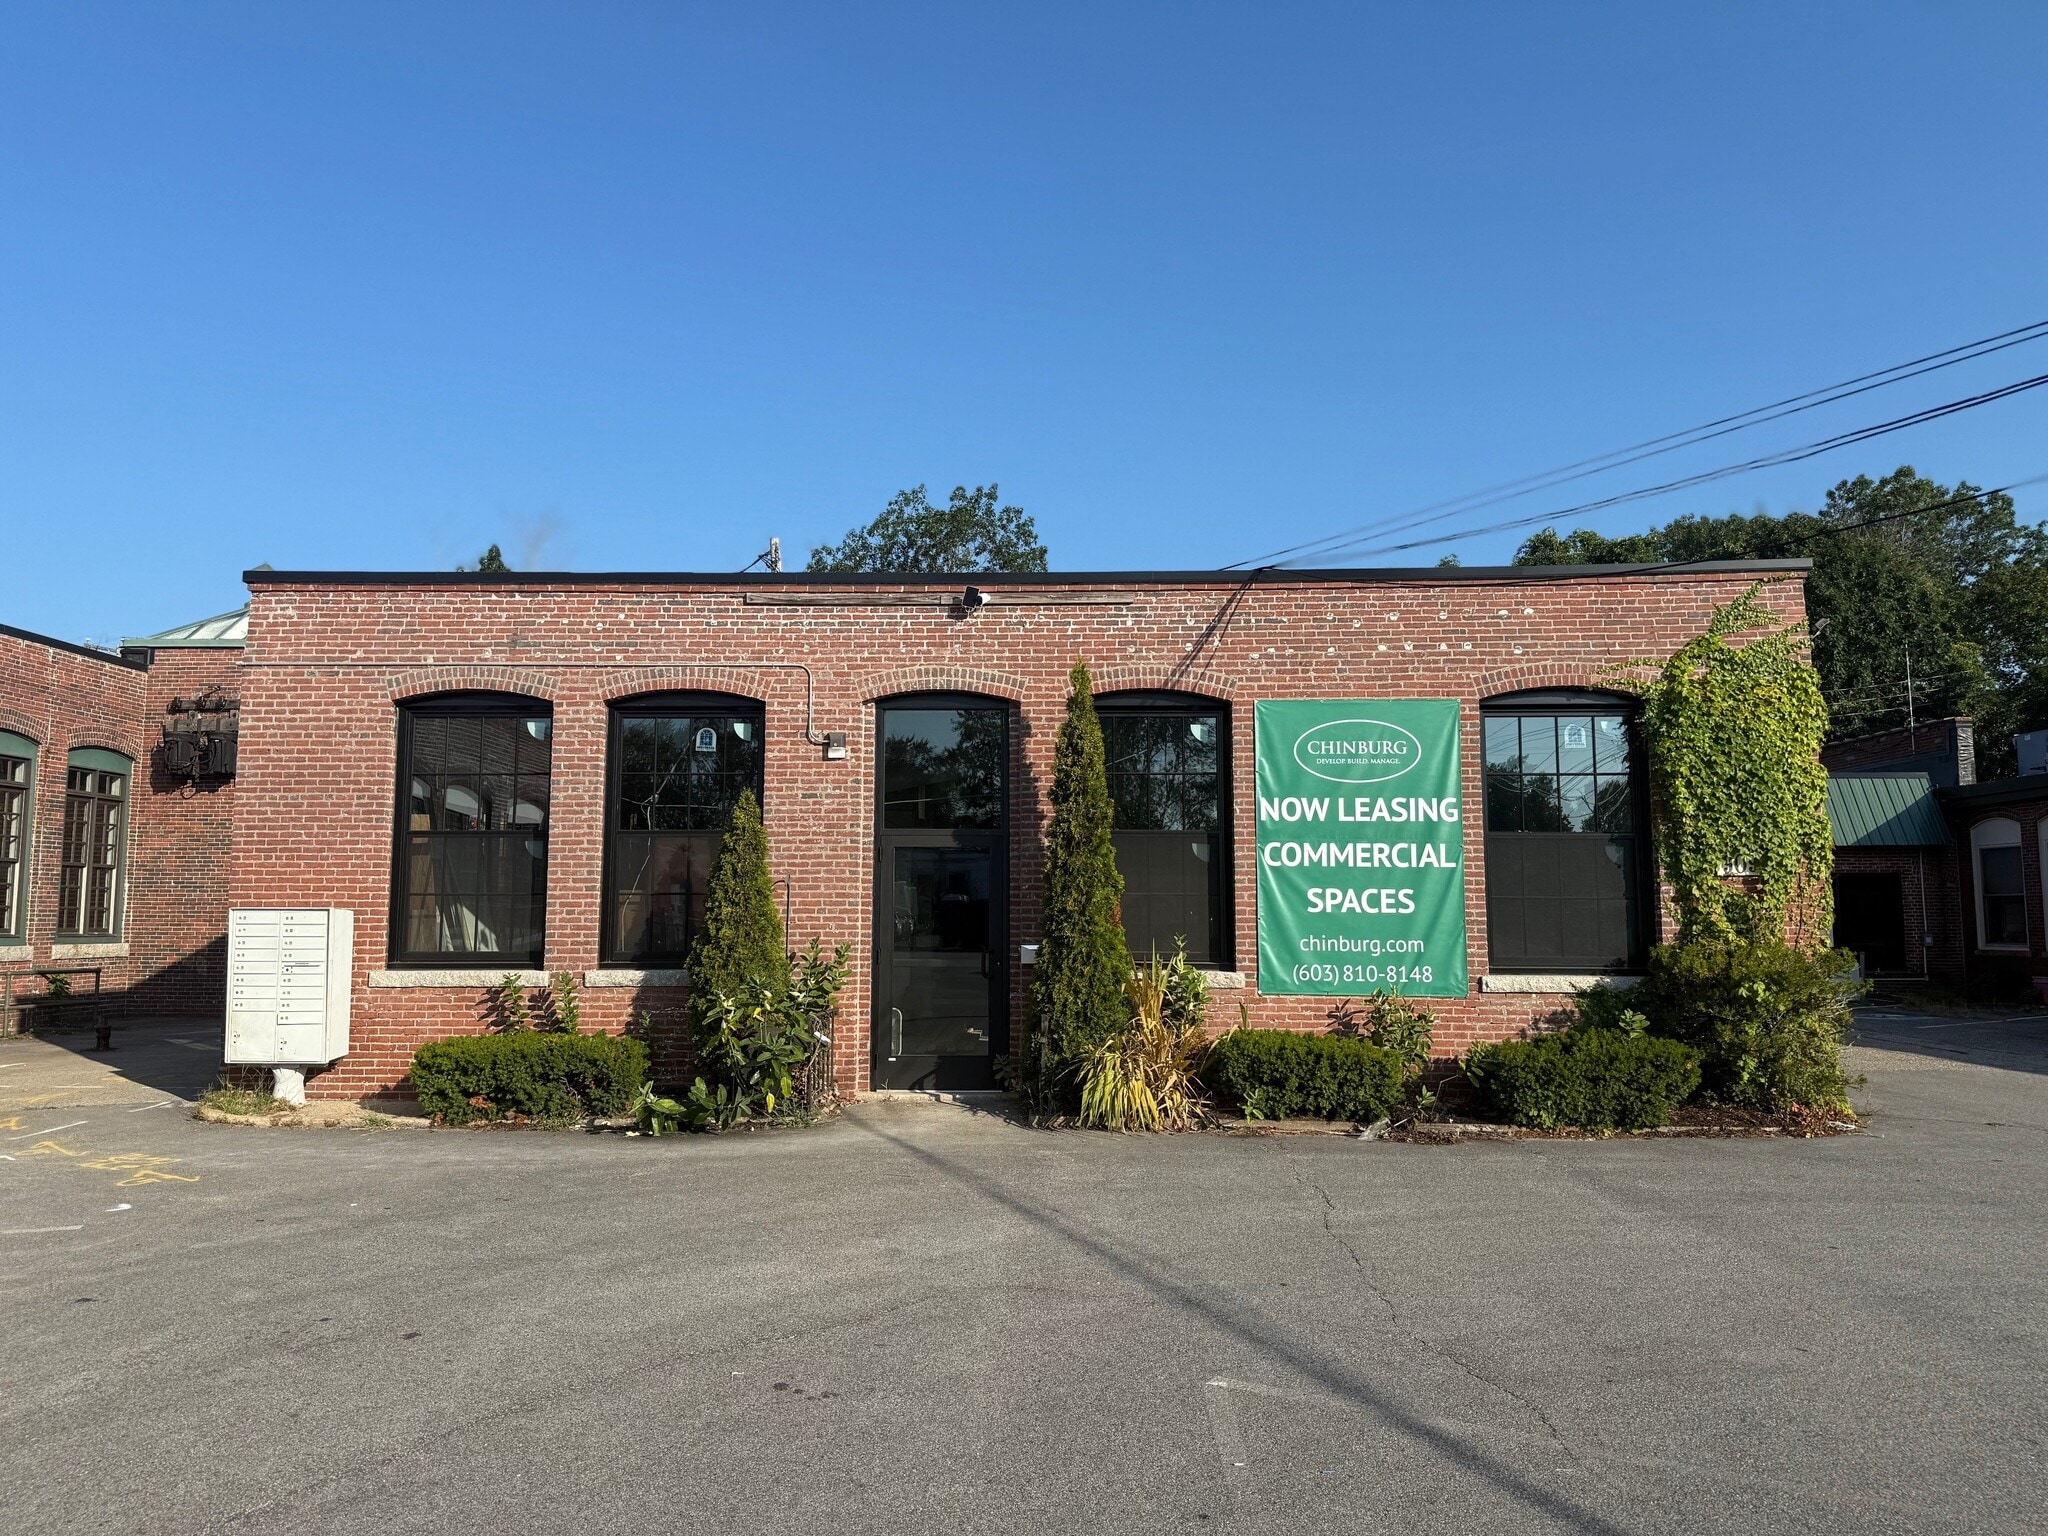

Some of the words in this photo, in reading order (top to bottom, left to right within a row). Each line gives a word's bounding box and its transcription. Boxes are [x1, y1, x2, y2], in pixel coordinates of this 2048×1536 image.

[1307, 740, 1407, 755] CHINBURG
[1260, 797, 1330, 822] NOW
[1338, 797, 1459, 822] LEASING
[1264, 841, 1456, 868] COMMERCIAL
[1306, 888, 1416, 914] SPACES
[1300, 935, 1424, 956] chinburg.com
[1293, 965, 1339, 986] (603)
[1343, 965, 1433, 983] 810-8148
